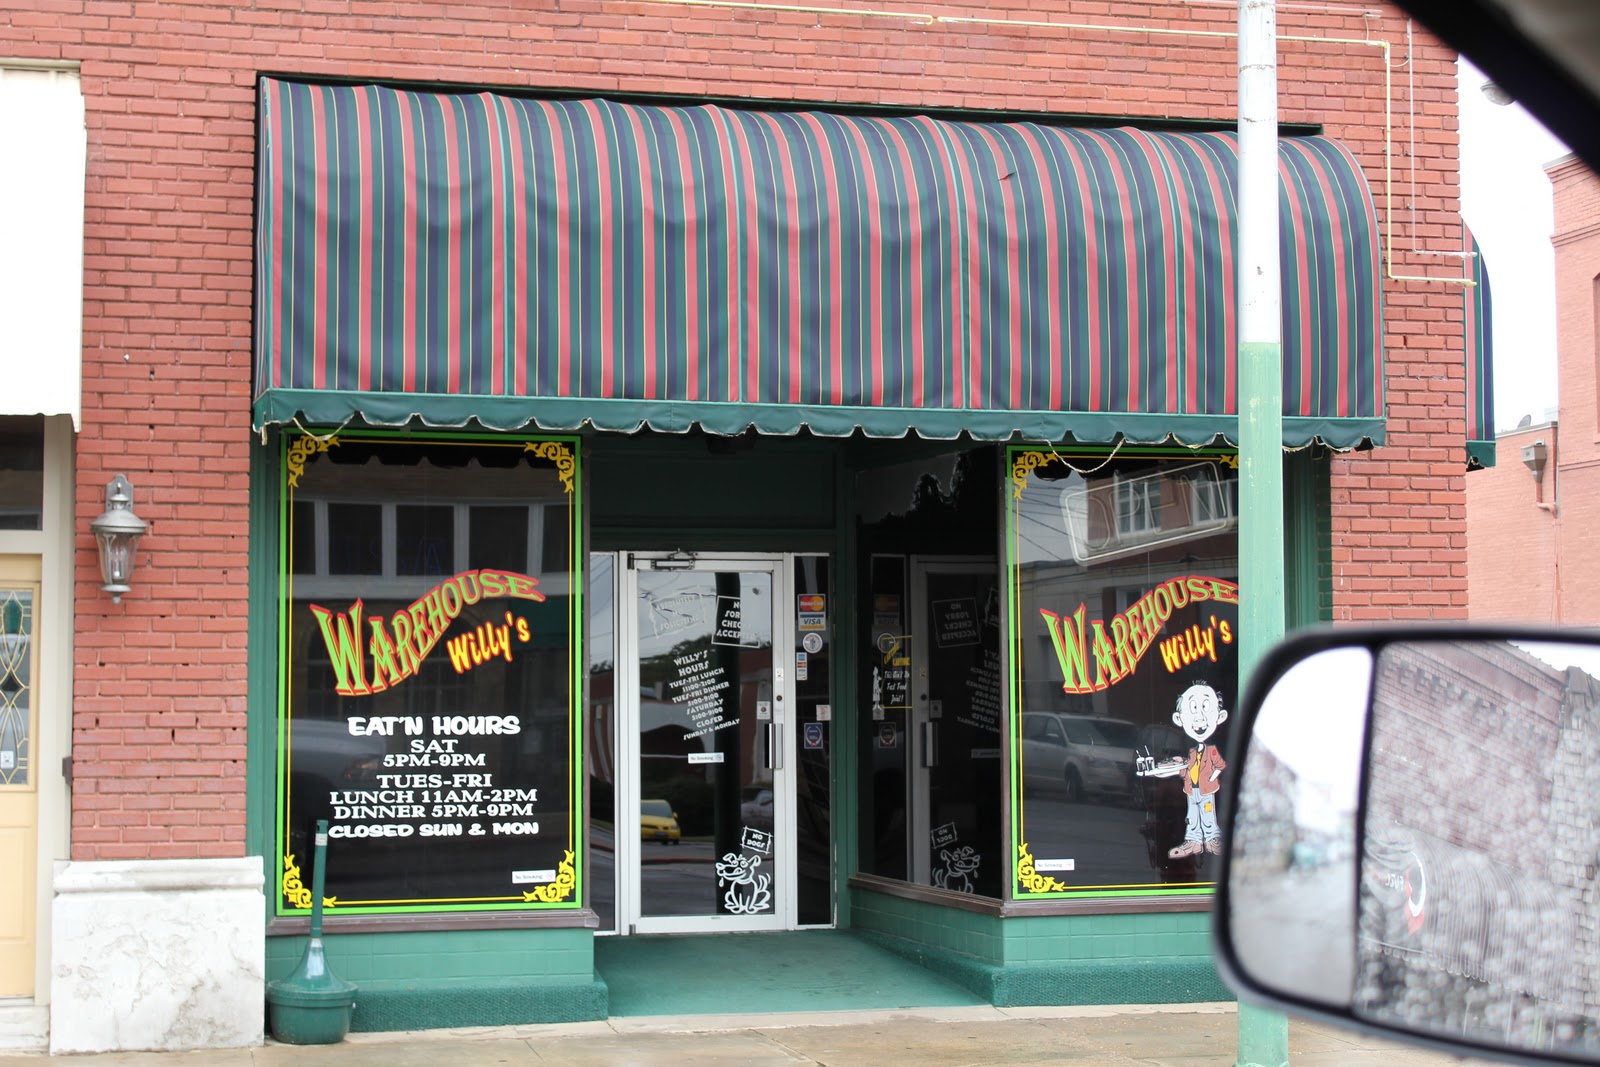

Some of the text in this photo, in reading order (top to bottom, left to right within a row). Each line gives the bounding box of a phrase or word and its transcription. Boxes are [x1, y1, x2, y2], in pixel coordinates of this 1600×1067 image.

[310, 569, 545, 696] WAREHOUSE
[1040, 575, 1239, 694] WAREHOUSE
[447, 611, 530, 674] Willy's
[1160, 615, 1233, 673] Willy's
[673, 649, 708, 666] WILLY'S
[678, 660, 710, 676] HOURS
[700, 667, 724, 680] LUNCH
[703, 681, 730, 694] DINNER
[686, 698, 724, 715] SATURDAY
[347, 715, 521, 737] EAT'N HOURS
[683, 728, 708, 740] SUNDAY
[714, 718, 740, 731] MONDAY
[696, 715, 723, 728] CLOSED
[410, 739, 458, 753] SAT
[383, 754, 486, 767] 5PM-9PM
[376, 774, 492, 789] TUES-FRI
[330, 789, 538, 805] LUNCH 11AM-2PM
[334, 803, 534, 819] DINNER 5PM-9PM
[328, 822, 539, 838] CLOSED SUN & MON
[747, 839, 765, 848] DOGS
